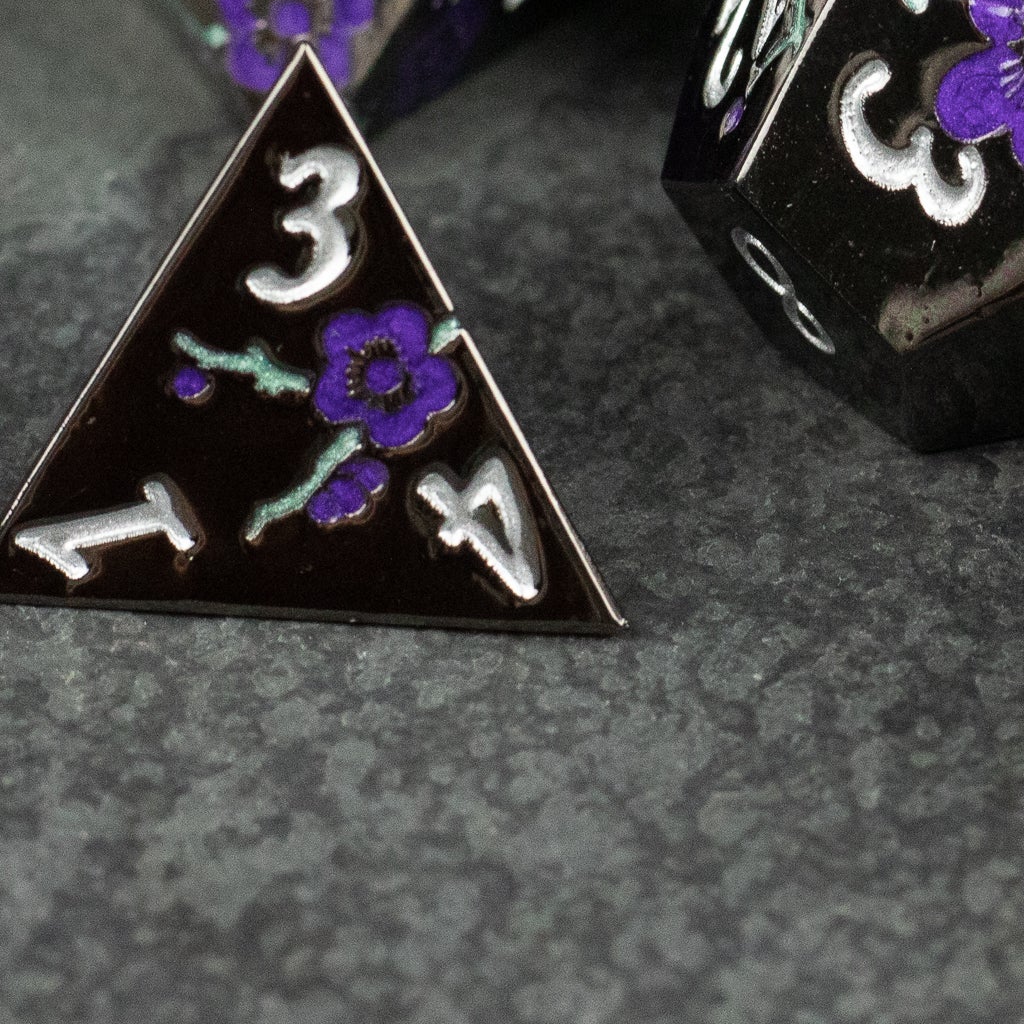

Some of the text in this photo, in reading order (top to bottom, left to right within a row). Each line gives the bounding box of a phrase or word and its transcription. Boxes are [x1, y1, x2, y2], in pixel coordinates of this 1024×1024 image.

[840, 59, 987, 227] 3
[245, 145, 361, 305] 3
[731, 227, 836, 355] 8
[13, 481, 196, 582] 1
[417, 457, 539, 601] 4
